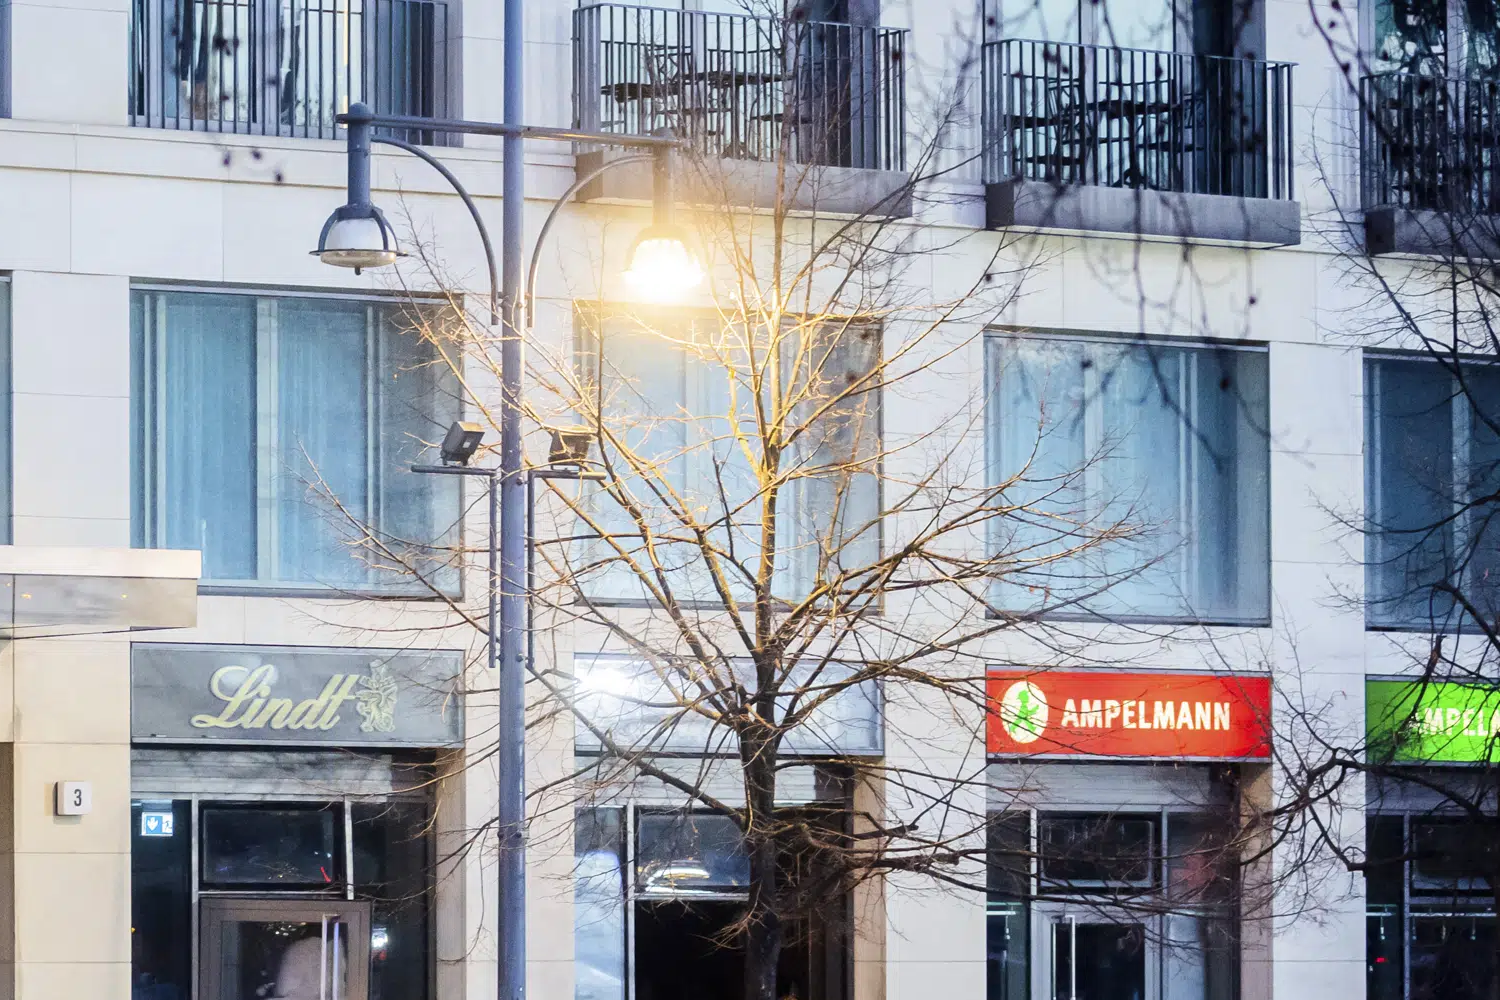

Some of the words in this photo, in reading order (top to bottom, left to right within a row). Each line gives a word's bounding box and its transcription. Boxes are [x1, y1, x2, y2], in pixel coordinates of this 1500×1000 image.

[192, 664, 361, 730] Lindt
[1061, 698, 1231, 731] AMPELMANN
[73, 788, 83, 807] 3
